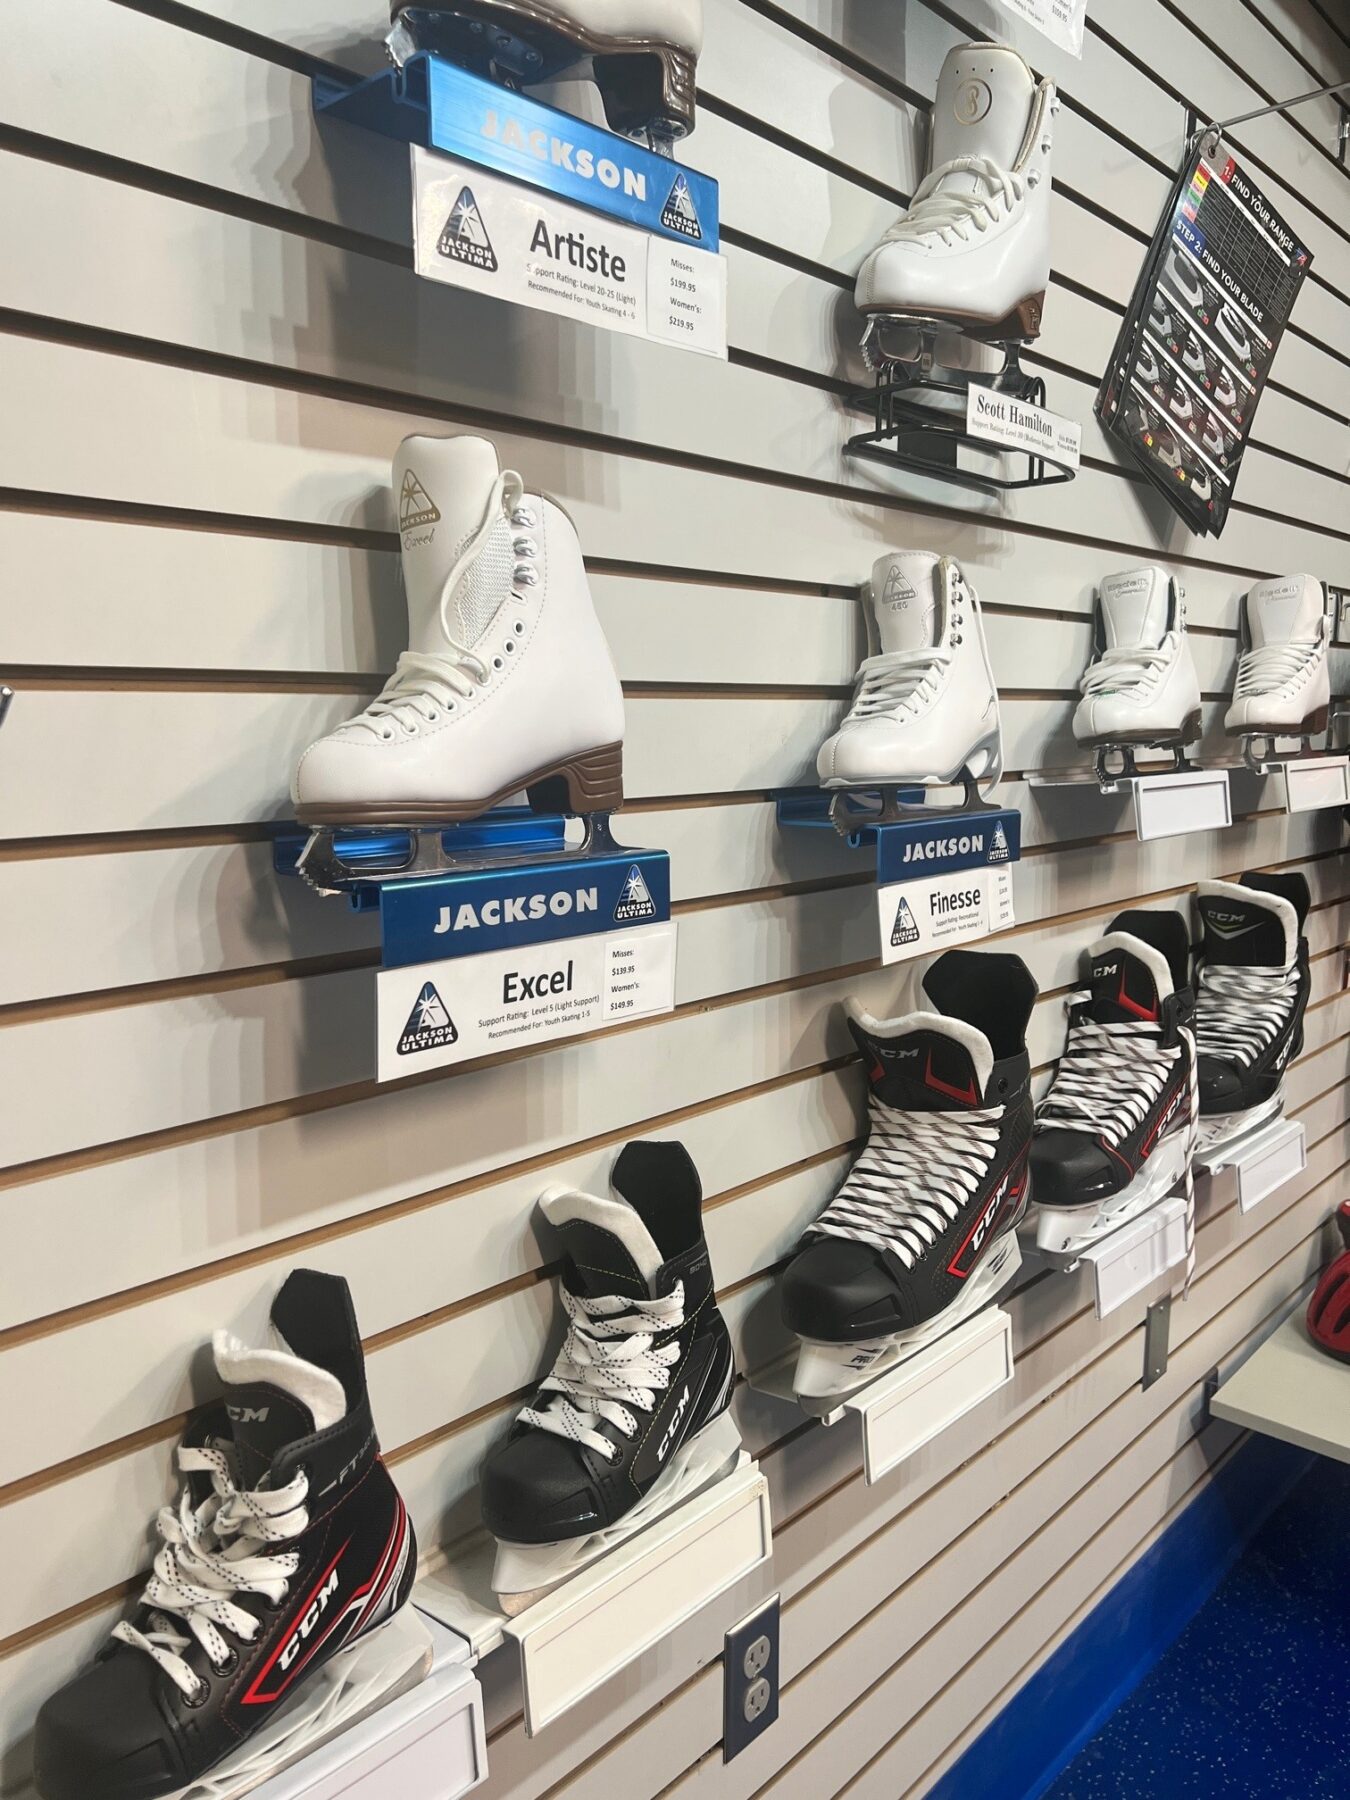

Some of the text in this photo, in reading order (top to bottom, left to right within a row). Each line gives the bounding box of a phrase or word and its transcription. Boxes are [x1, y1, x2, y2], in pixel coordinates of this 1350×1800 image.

[480, 110, 647, 201] JACKSON
[663, 210, 699, 231] JACKSON
[1231, 174, 1250, 199] FIND
[1250, 194, 1271, 227] YOUR
[1270, 217, 1295, 252] RANGE
[663, 217, 700, 238] ULTIMA
[441, 235, 492, 260] JACKSON
[441, 244, 494, 269] ULTIMA
[529, 219, 627, 283] Artiste
[670, 258, 695, 273] Misses:
[1176, 219, 1195, 243] STEP
[1194, 239, 1203, 256] 2:
[1202, 249, 1220, 275] FIND
[1220, 267, 1241, 296] YOUR
[1240, 291, 1265, 324] BLADE
[526, 263, 637, 306] Spport Rating: Level 20-25 (Light)
[670, 277, 697, 293] $199.95
[528, 280, 573, 301] Recommended
[573, 293, 585, 305] For:
[585, 297, 601, 310] Youth
[601, 303, 623, 317] Skating
[670, 296, 703, 314] Women's:
[668, 315, 695, 332] $219.95
[977, 394, 1053, 438] Scott Hamilton
[902, 834, 984, 863] JACKSON
[433, 886, 598, 934] JACKSON
[616, 908, 653, 919] ULTIMA
[617, 902, 652, 913] JACKSON
[930, 888, 981, 916] Finesse
[1207, 909, 1246, 922] CCM
[893, 933, 919, 945] ULTIMA
[502, 959, 574, 1004] Excel
[611, 965, 635, 976] $139.95
[1093, 964, 1118, 977] CM
[478, 994, 600, 1028] Support Rating: Level 5 (Light Support)
[610, 999, 634, 1011] $149.95
[401, 1026, 453, 1044] JACKSON
[488, 1022, 532, 1040] Recommended
[532, 1021, 543, 1030] For:
[544, 1016, 561, 1027] Youth
[561, 1011, 581, 1024] Skating
[401, 1033, 454, 1052] ULTIMA
[880, 1047, 920, 1059] CM
[971, 1174, 1009, 1251] CCM
[224, 1400, 271, 1423] CM
[656, 1384, 690, 1462] CCM
[277, 1568, 339, 1671] CCM
